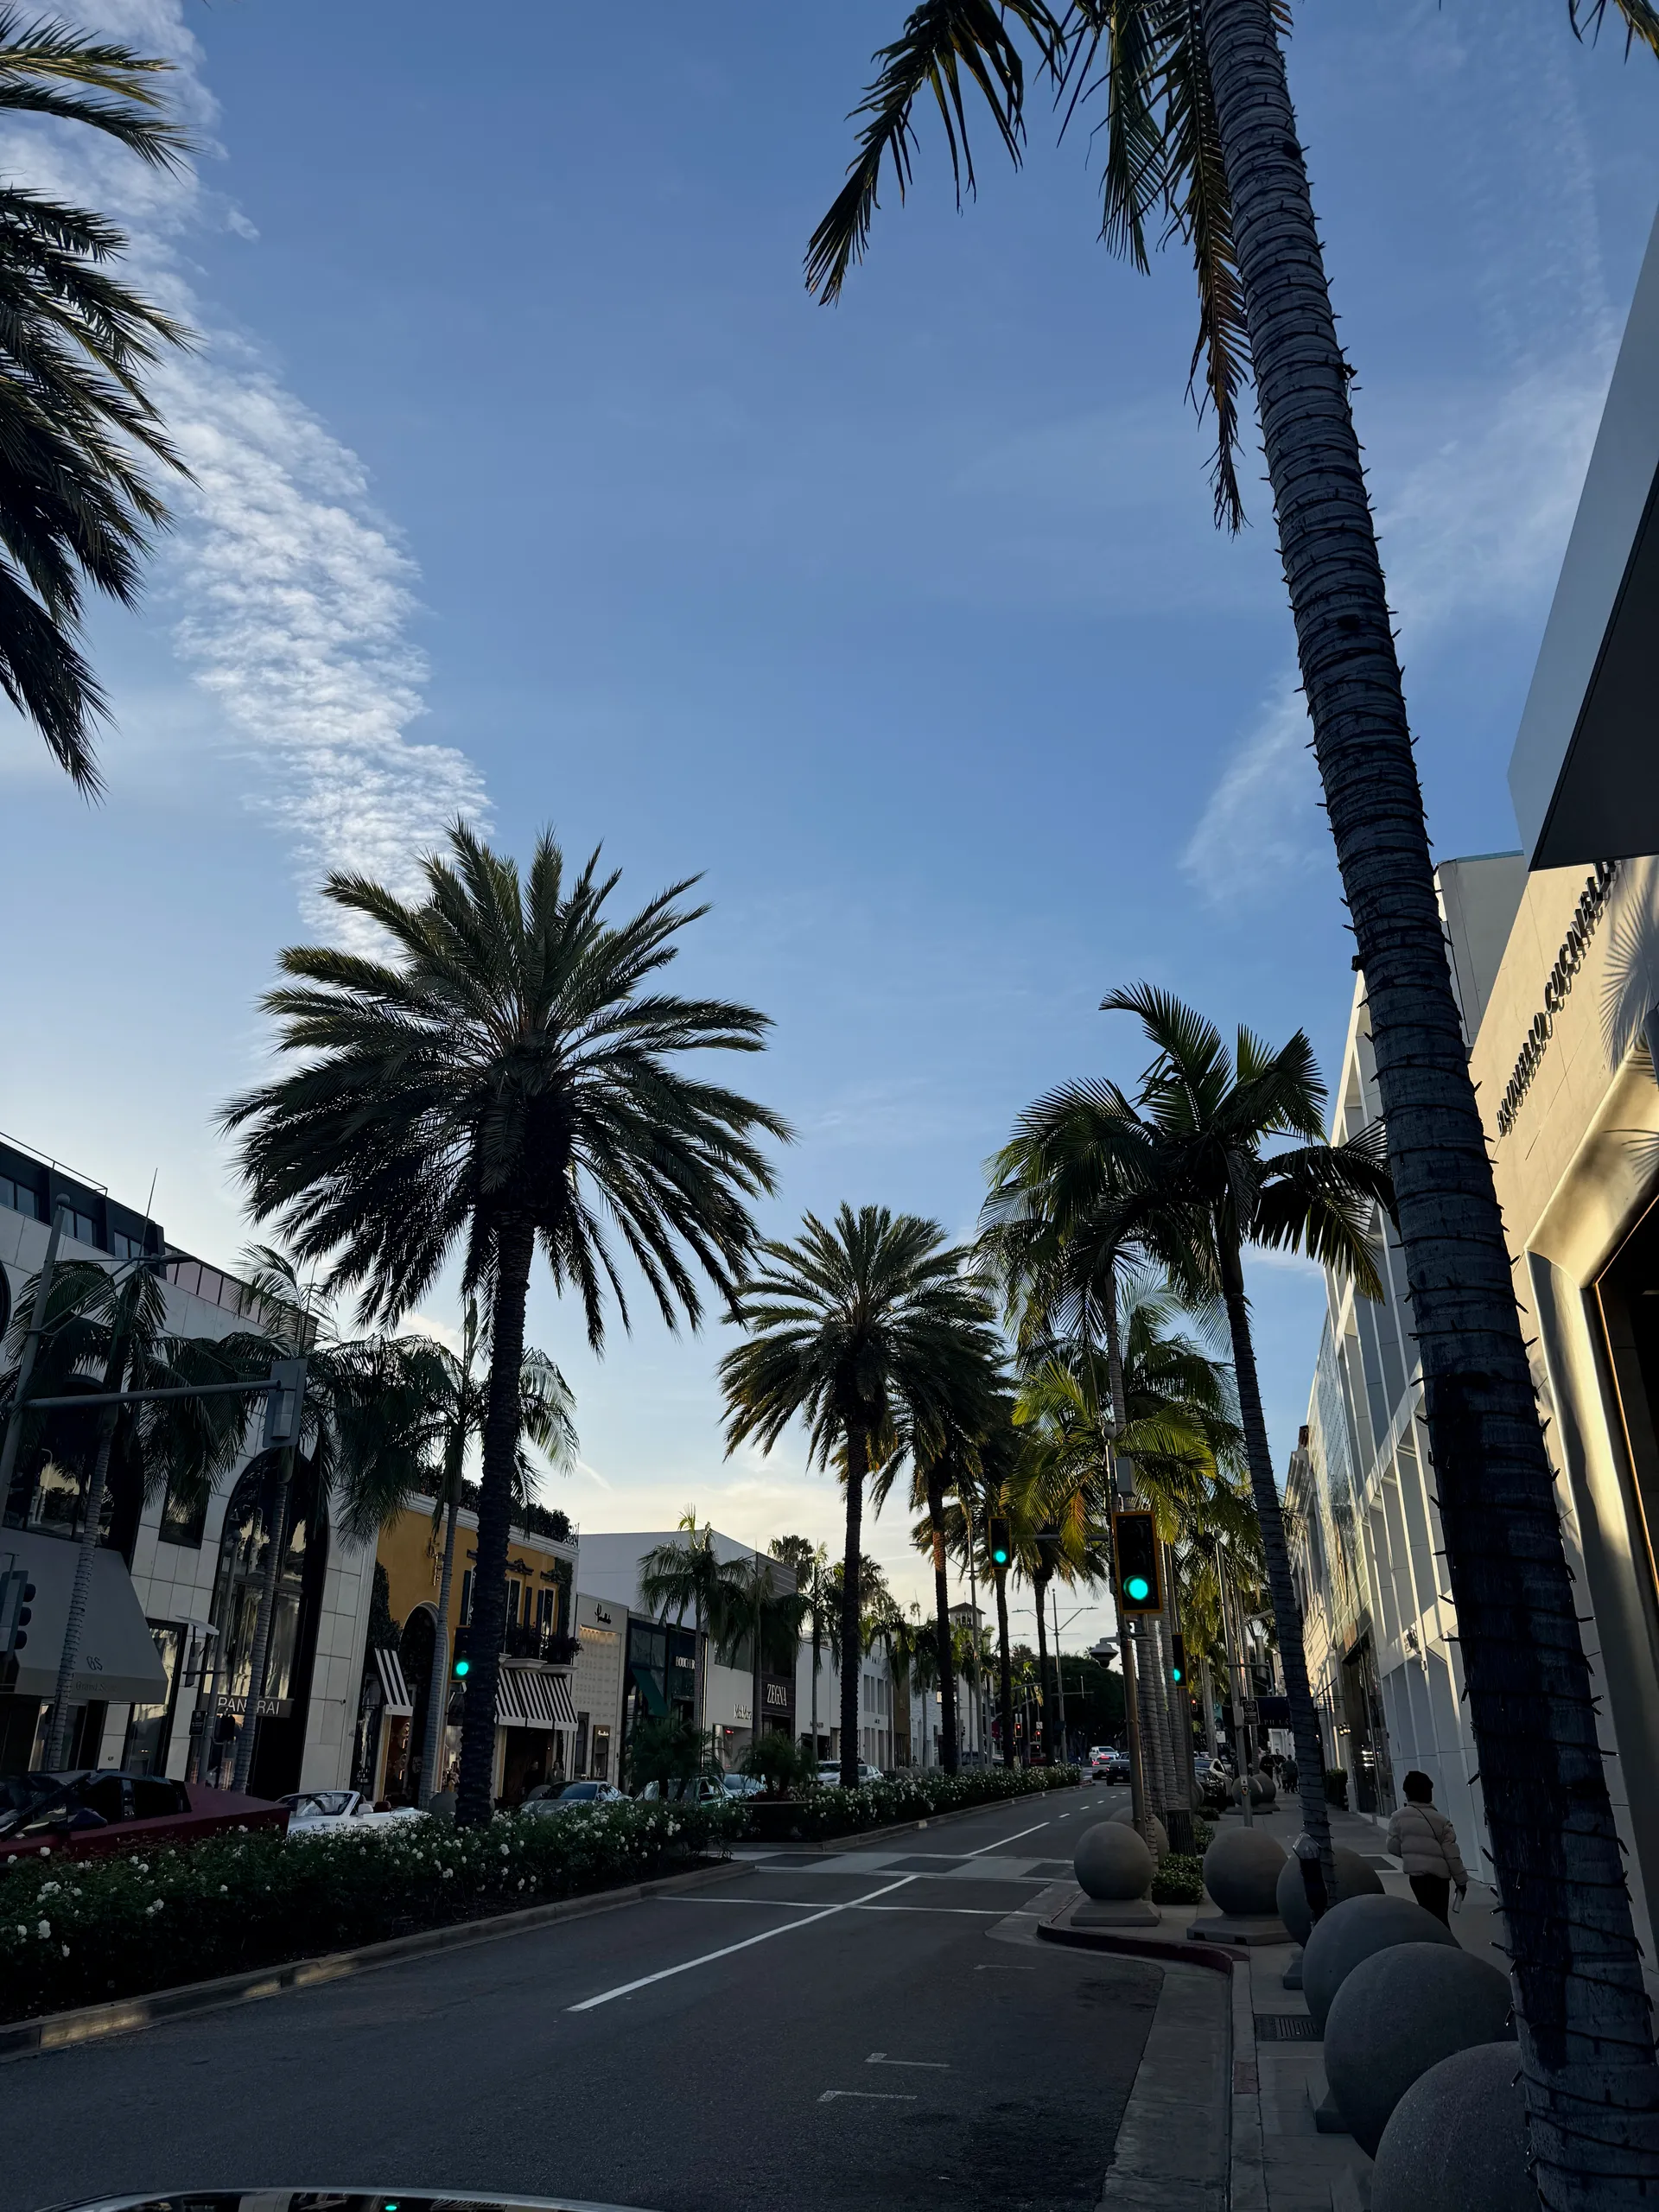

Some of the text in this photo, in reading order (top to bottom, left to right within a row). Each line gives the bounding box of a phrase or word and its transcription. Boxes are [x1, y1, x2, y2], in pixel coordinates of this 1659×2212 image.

[1497, 861, 1617, 1137] BRUNELLO CUCINELL
[218, 1696, 280, 1715] PANRAI
[766, 1683, 787, 1707] ZEGNA
